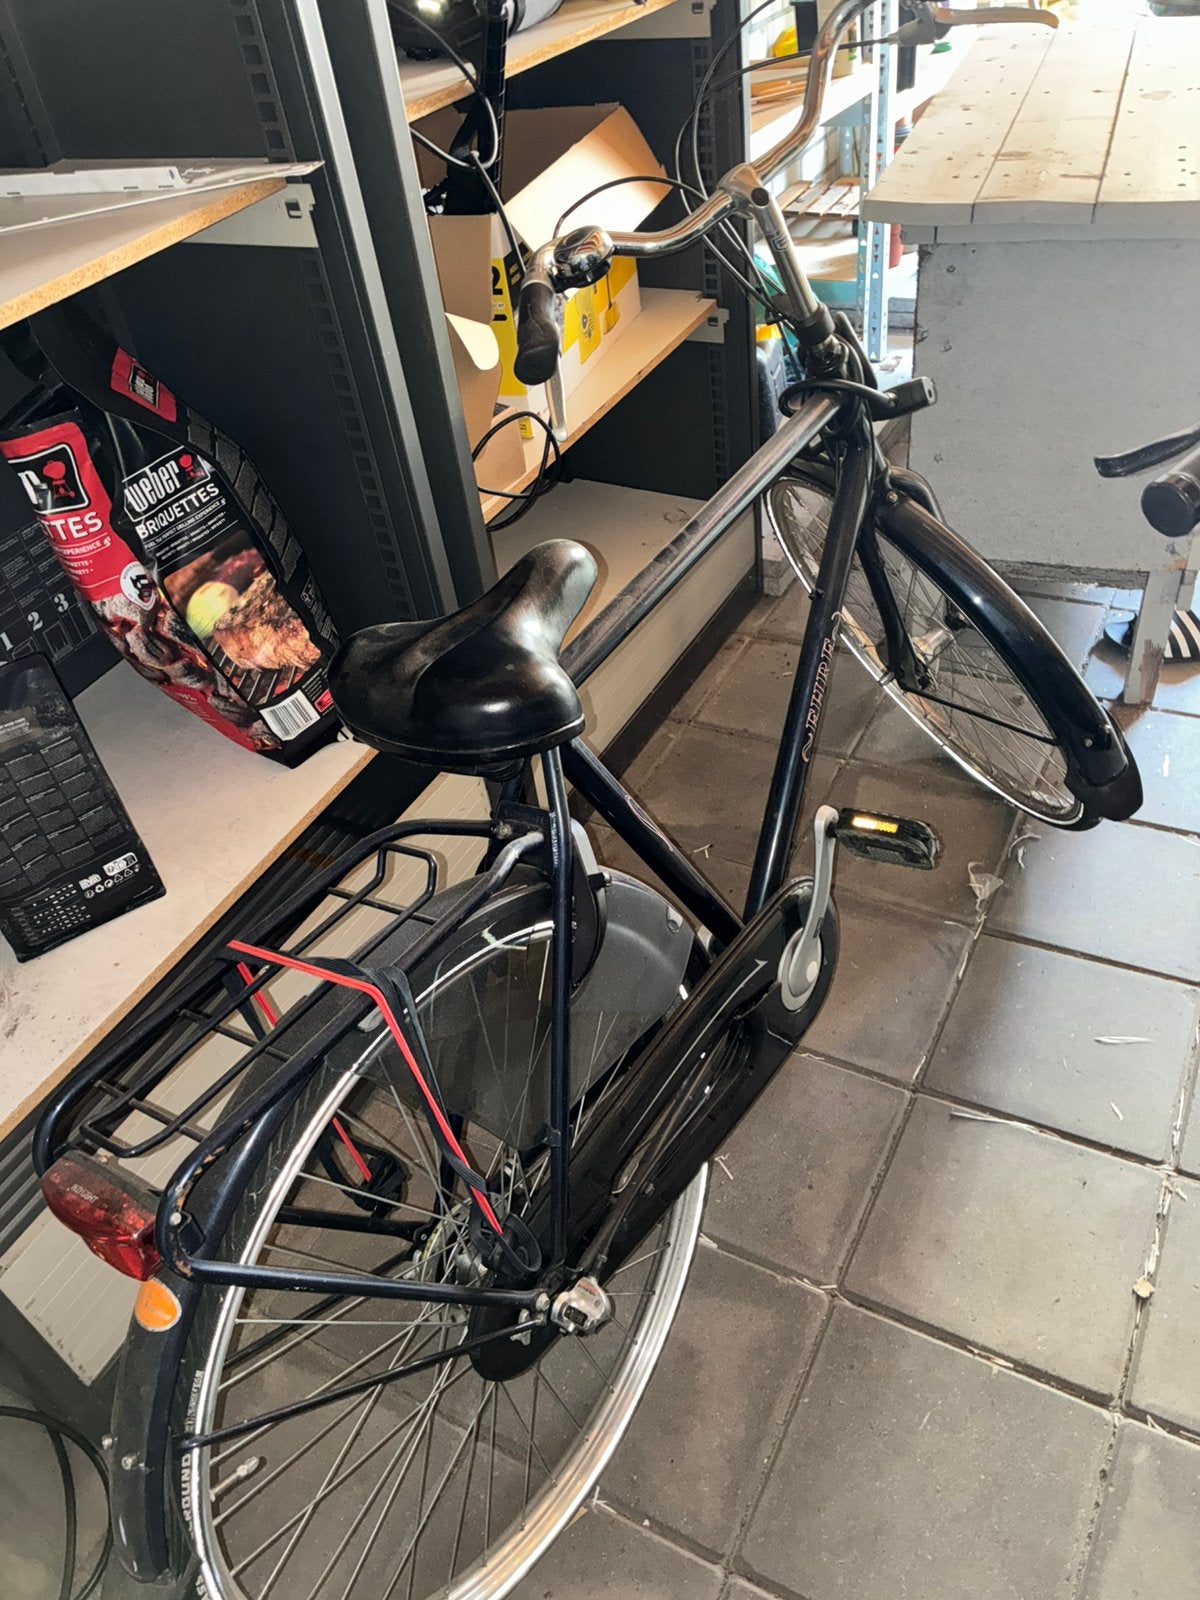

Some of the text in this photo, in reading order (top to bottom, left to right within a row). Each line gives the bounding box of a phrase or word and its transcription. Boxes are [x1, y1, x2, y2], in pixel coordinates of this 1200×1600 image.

[135, 483, 219, 540] BRIQUETTES
[0, 593, 69, 651] 1 2 3
